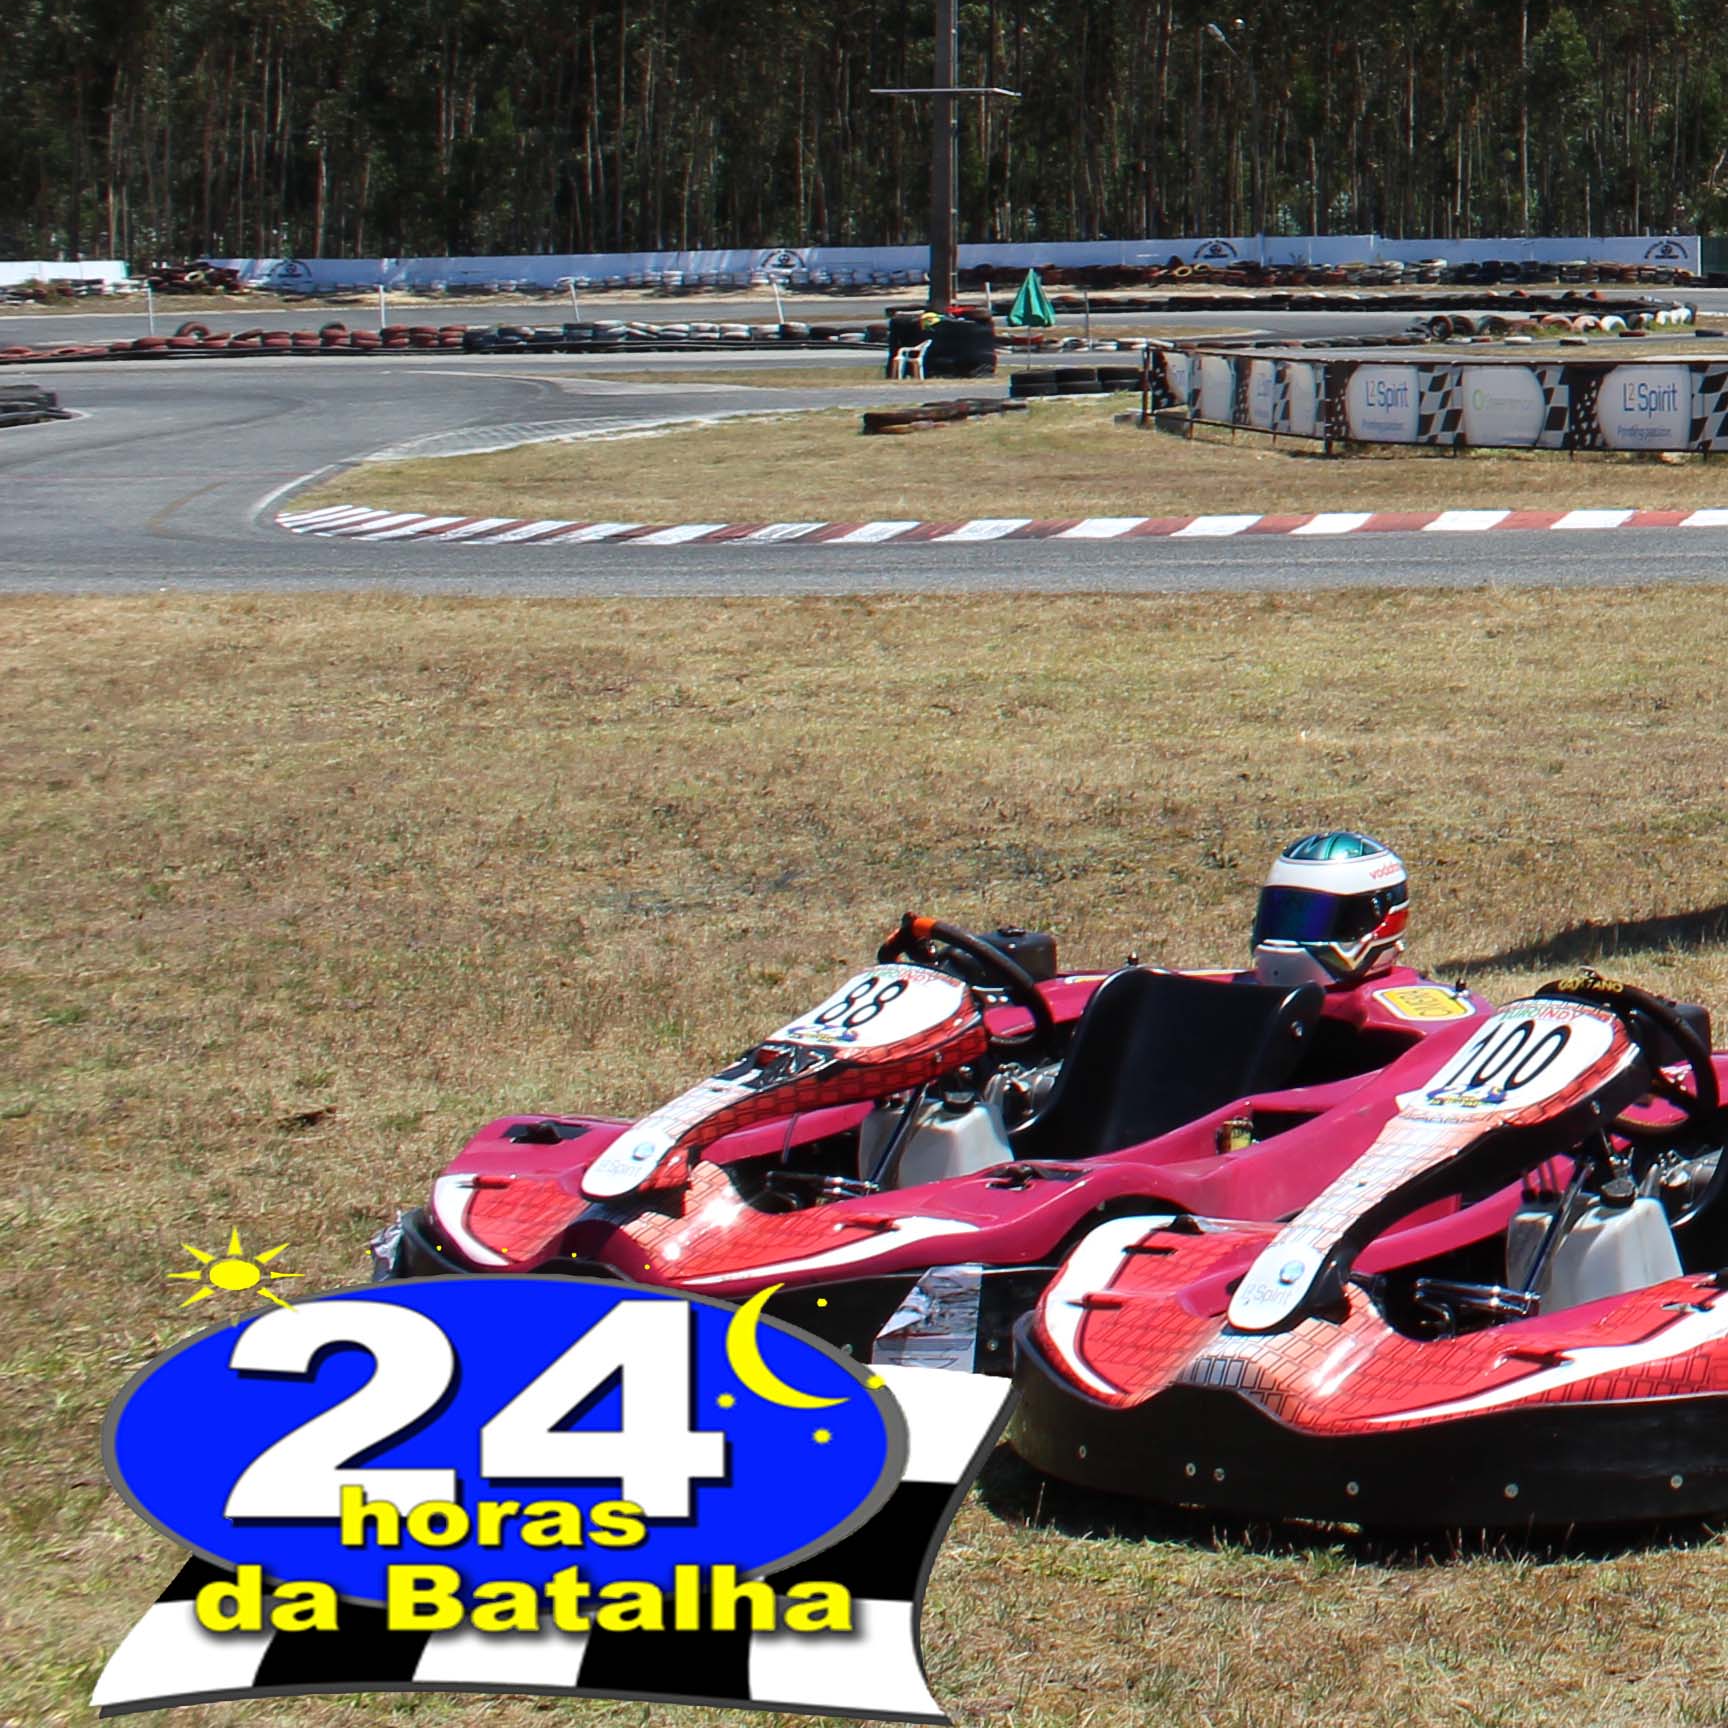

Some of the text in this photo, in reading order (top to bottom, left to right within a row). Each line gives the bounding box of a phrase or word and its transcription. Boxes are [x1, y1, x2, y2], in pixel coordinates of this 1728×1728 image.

[1637, 382, 1678, 419] Spirit
[814, 976, 909, 1028] 88
[1445, 1019, 1572, 1091] 100
